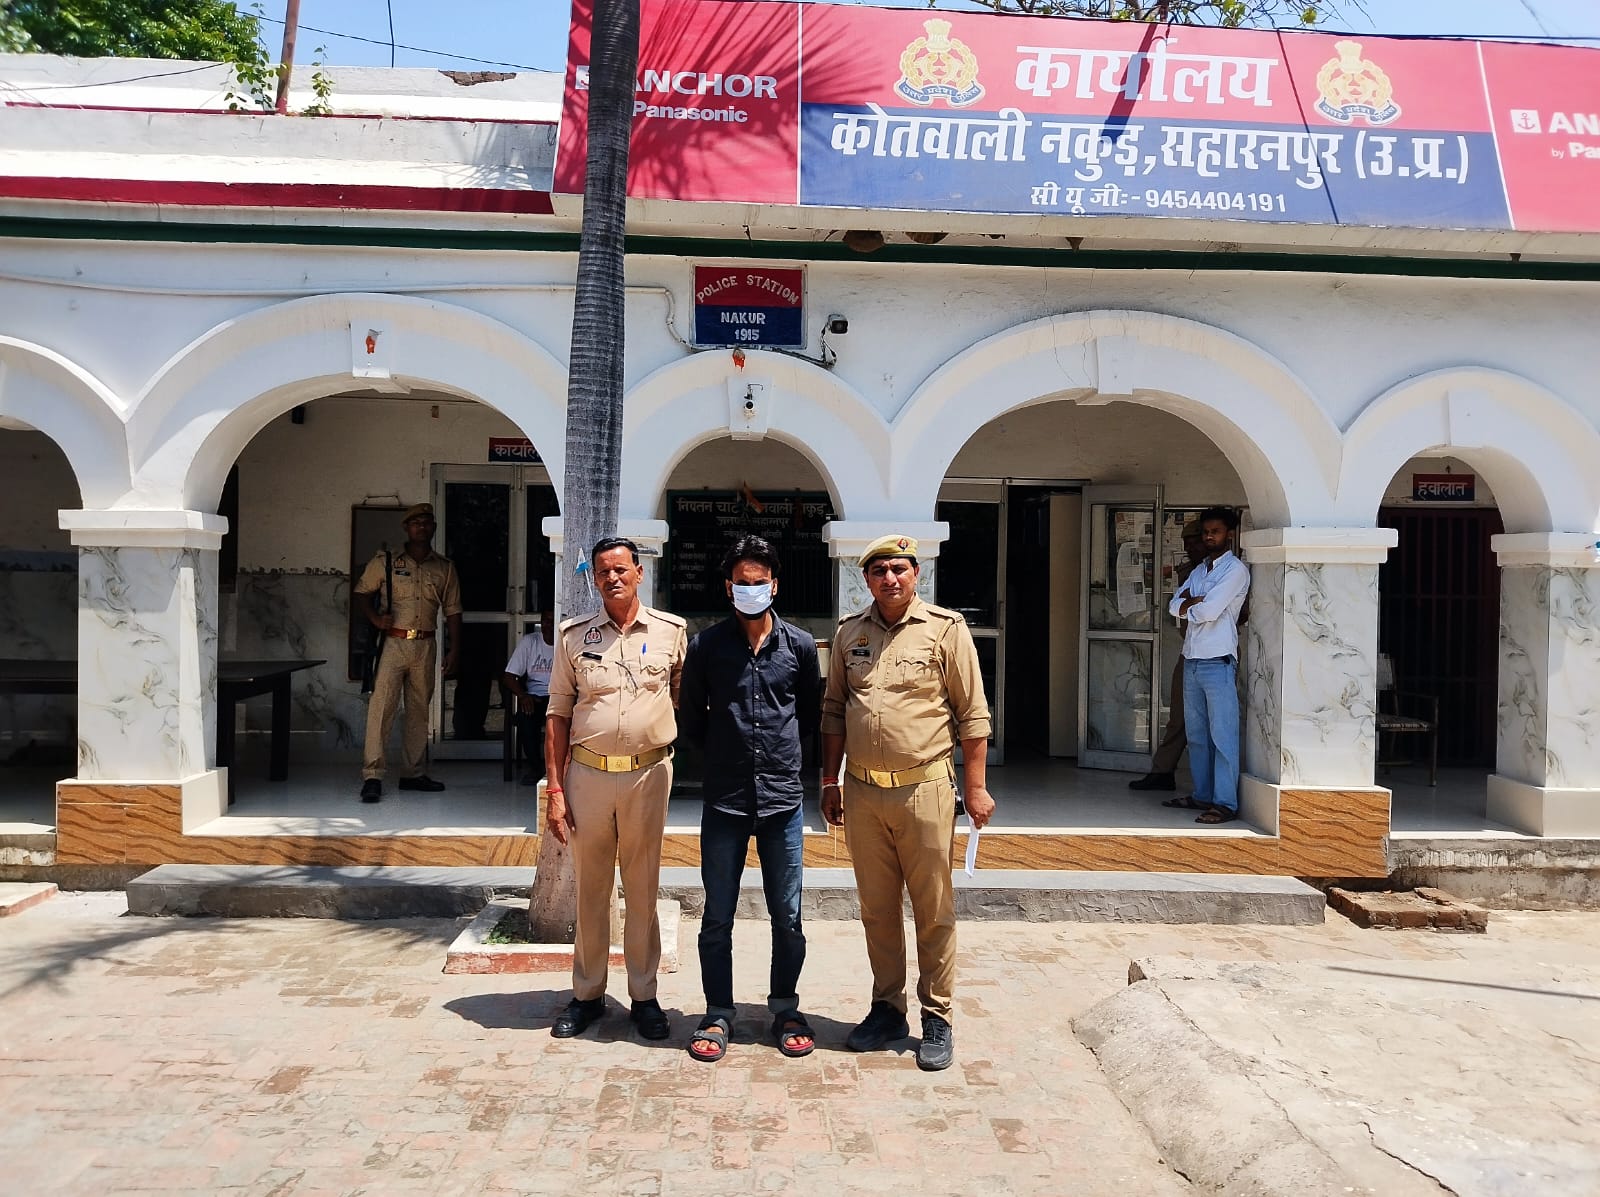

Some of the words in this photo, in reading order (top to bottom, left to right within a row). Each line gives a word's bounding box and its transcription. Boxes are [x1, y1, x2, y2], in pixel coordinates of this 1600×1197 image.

[636, 69, 778, 98] NCHOR
[1015, 37, 1278, 106] कार्यालय
[632, 100, 748, 122] Panasonic
[831, 102, 1032, 162] कोतवाली
[1551, 147, 1566, 160] by
[1031, 181, 1061, 206] सी
[1145, 189, 1286, 213] 9454404191
[696, 276, 738, 303] POLICE
[746, 275, 799, 304] STATION
[720, 312, 766, 325] NAKUR
[734, 328, 760, 341] 1915
[1417, 481, 1468, 501] हवालात
